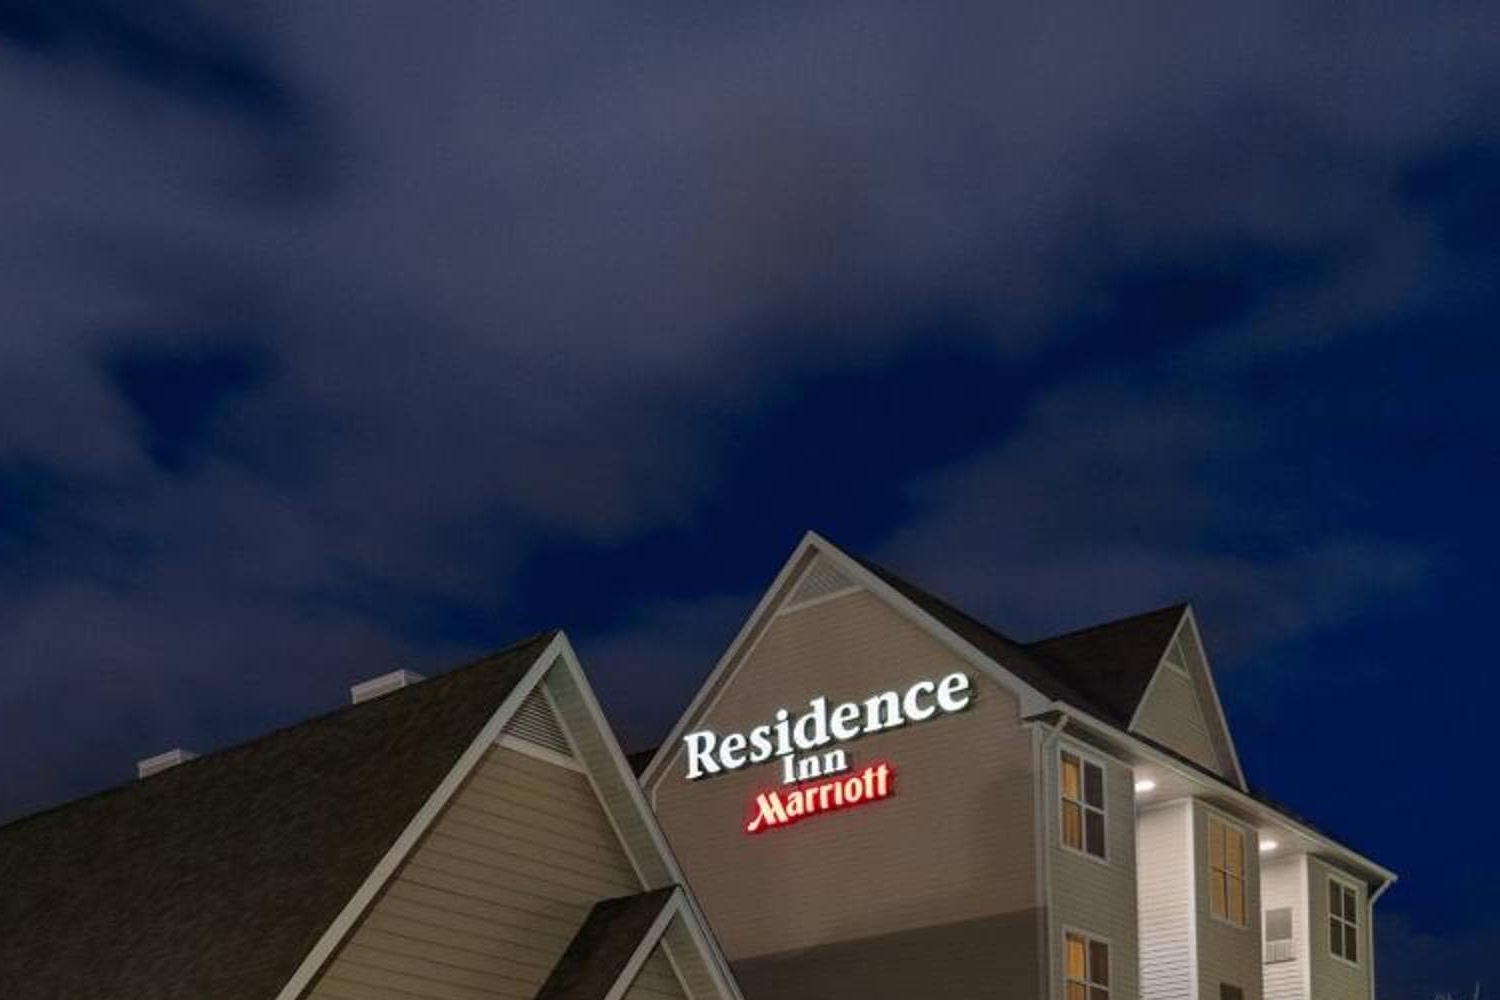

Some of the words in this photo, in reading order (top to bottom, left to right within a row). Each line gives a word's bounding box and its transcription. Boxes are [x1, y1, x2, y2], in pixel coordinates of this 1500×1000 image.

[683, 671, 970, 780] Residence
[747, 762, 890, 832] Marriott
[783, 748, 849, 784] Inn
